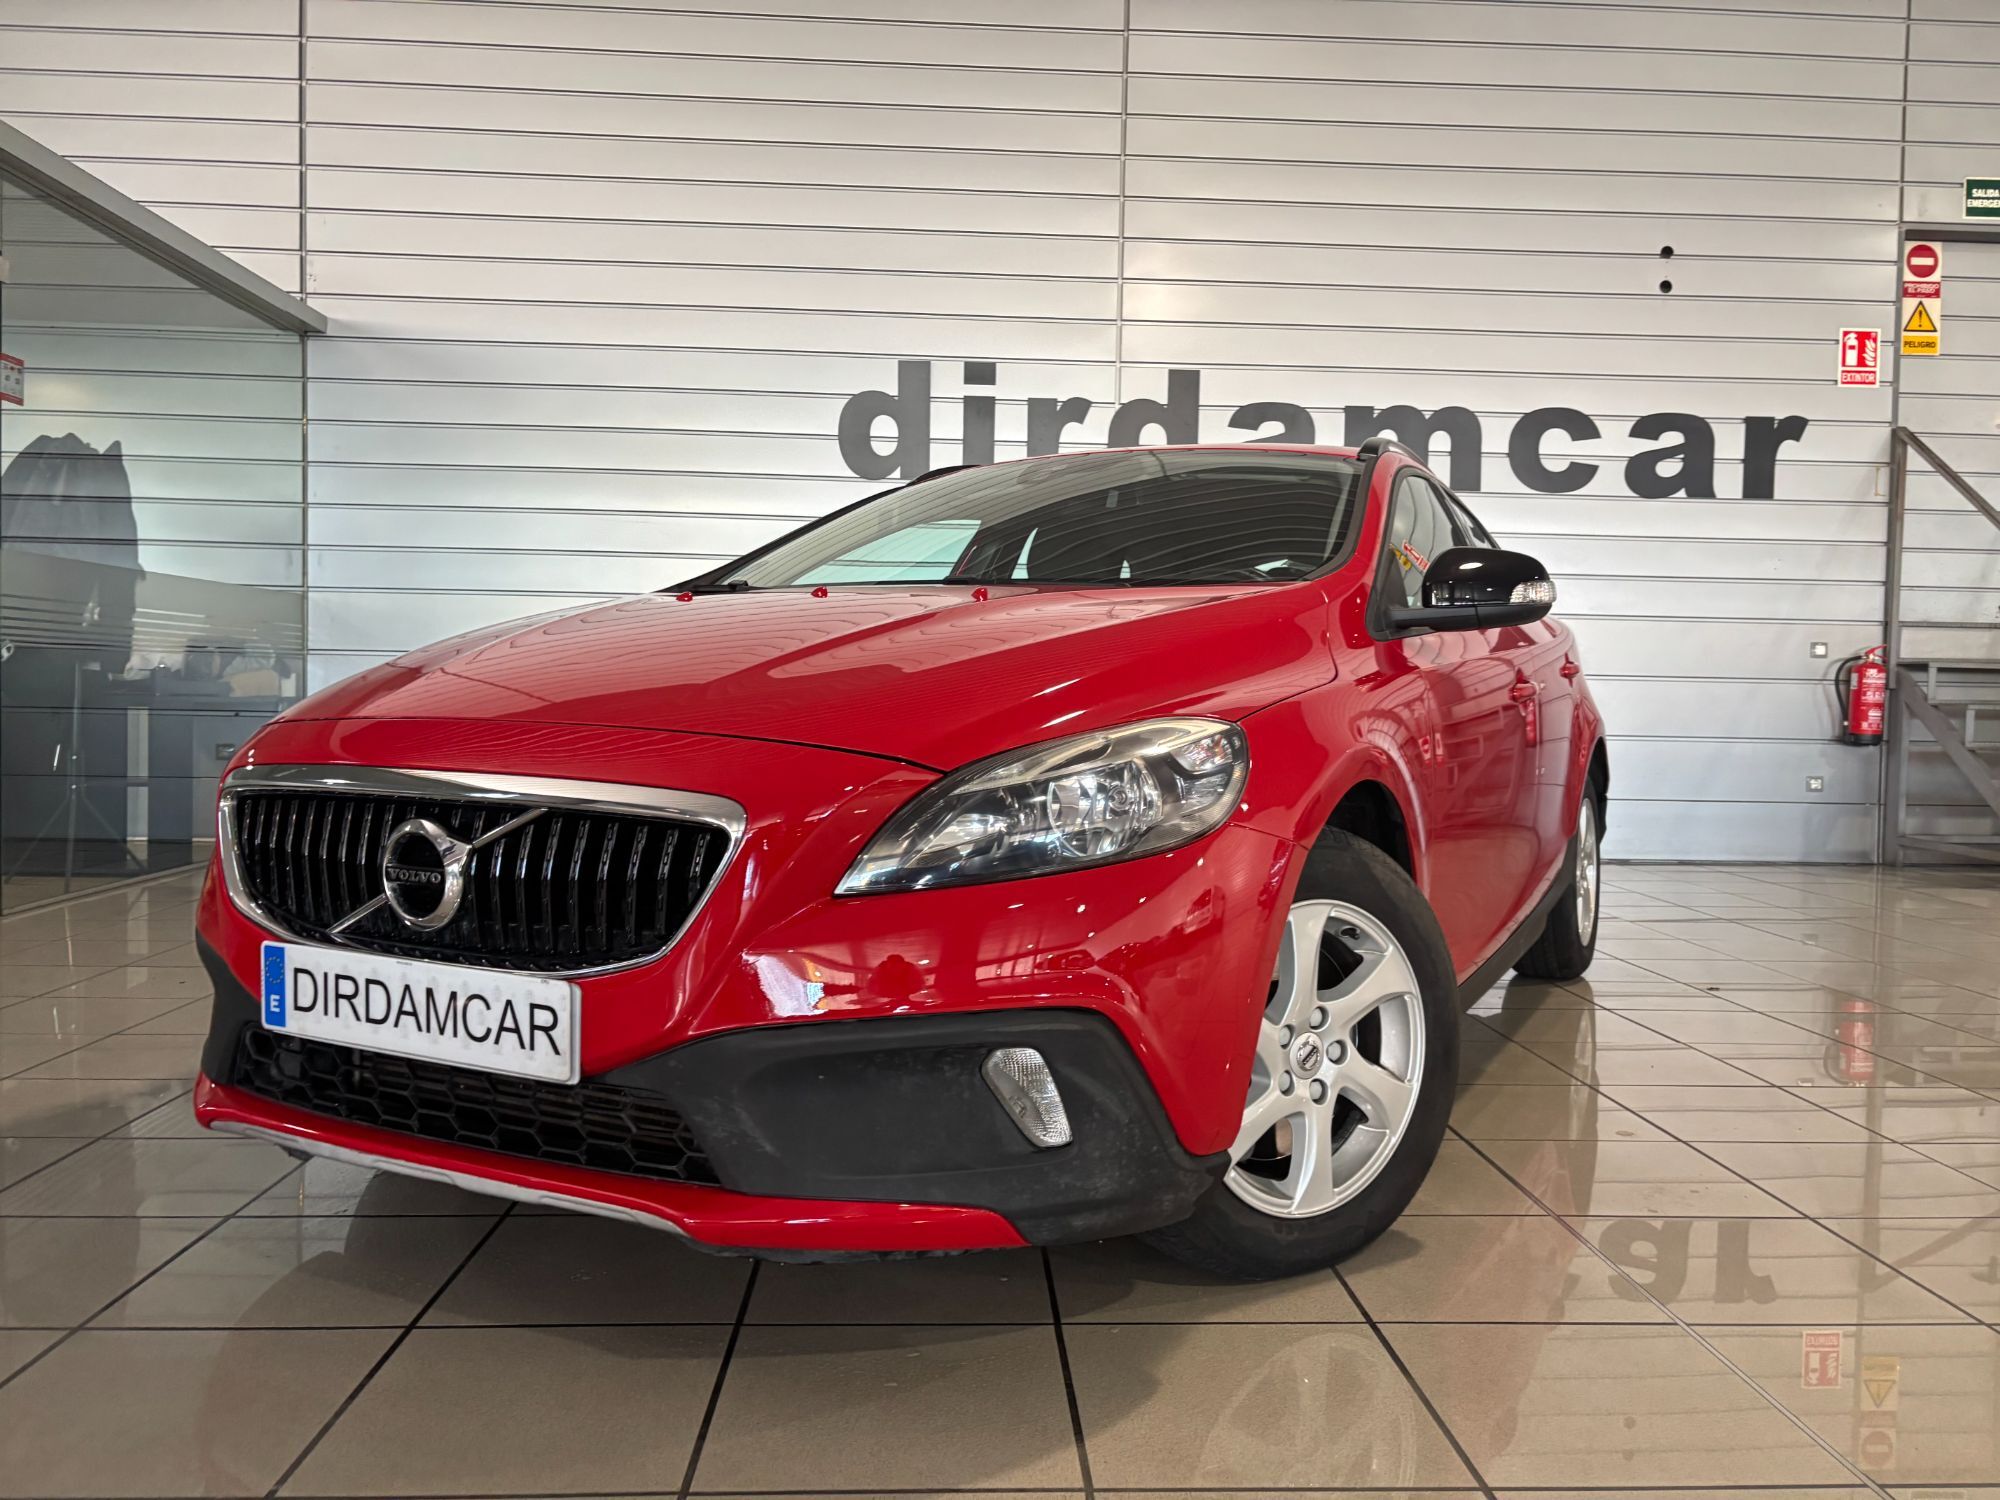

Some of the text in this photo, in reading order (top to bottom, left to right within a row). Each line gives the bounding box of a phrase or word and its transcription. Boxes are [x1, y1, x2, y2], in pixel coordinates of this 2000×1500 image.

[1971, 188, 2000, 198] SALIDA
[1967, 199, 2000, 208] EMERGE
[1903, 340, 1936, 349] PELIGRO
[1841, 372, 1876, 383] EXTINTOR
[838, 359, 1808, 500] dirdamcar
[387, 868, 441, 883] VOLVO
[270, 994, 281, 1013] E
[292, 966, 562, 1056] DIRDAMCAR
